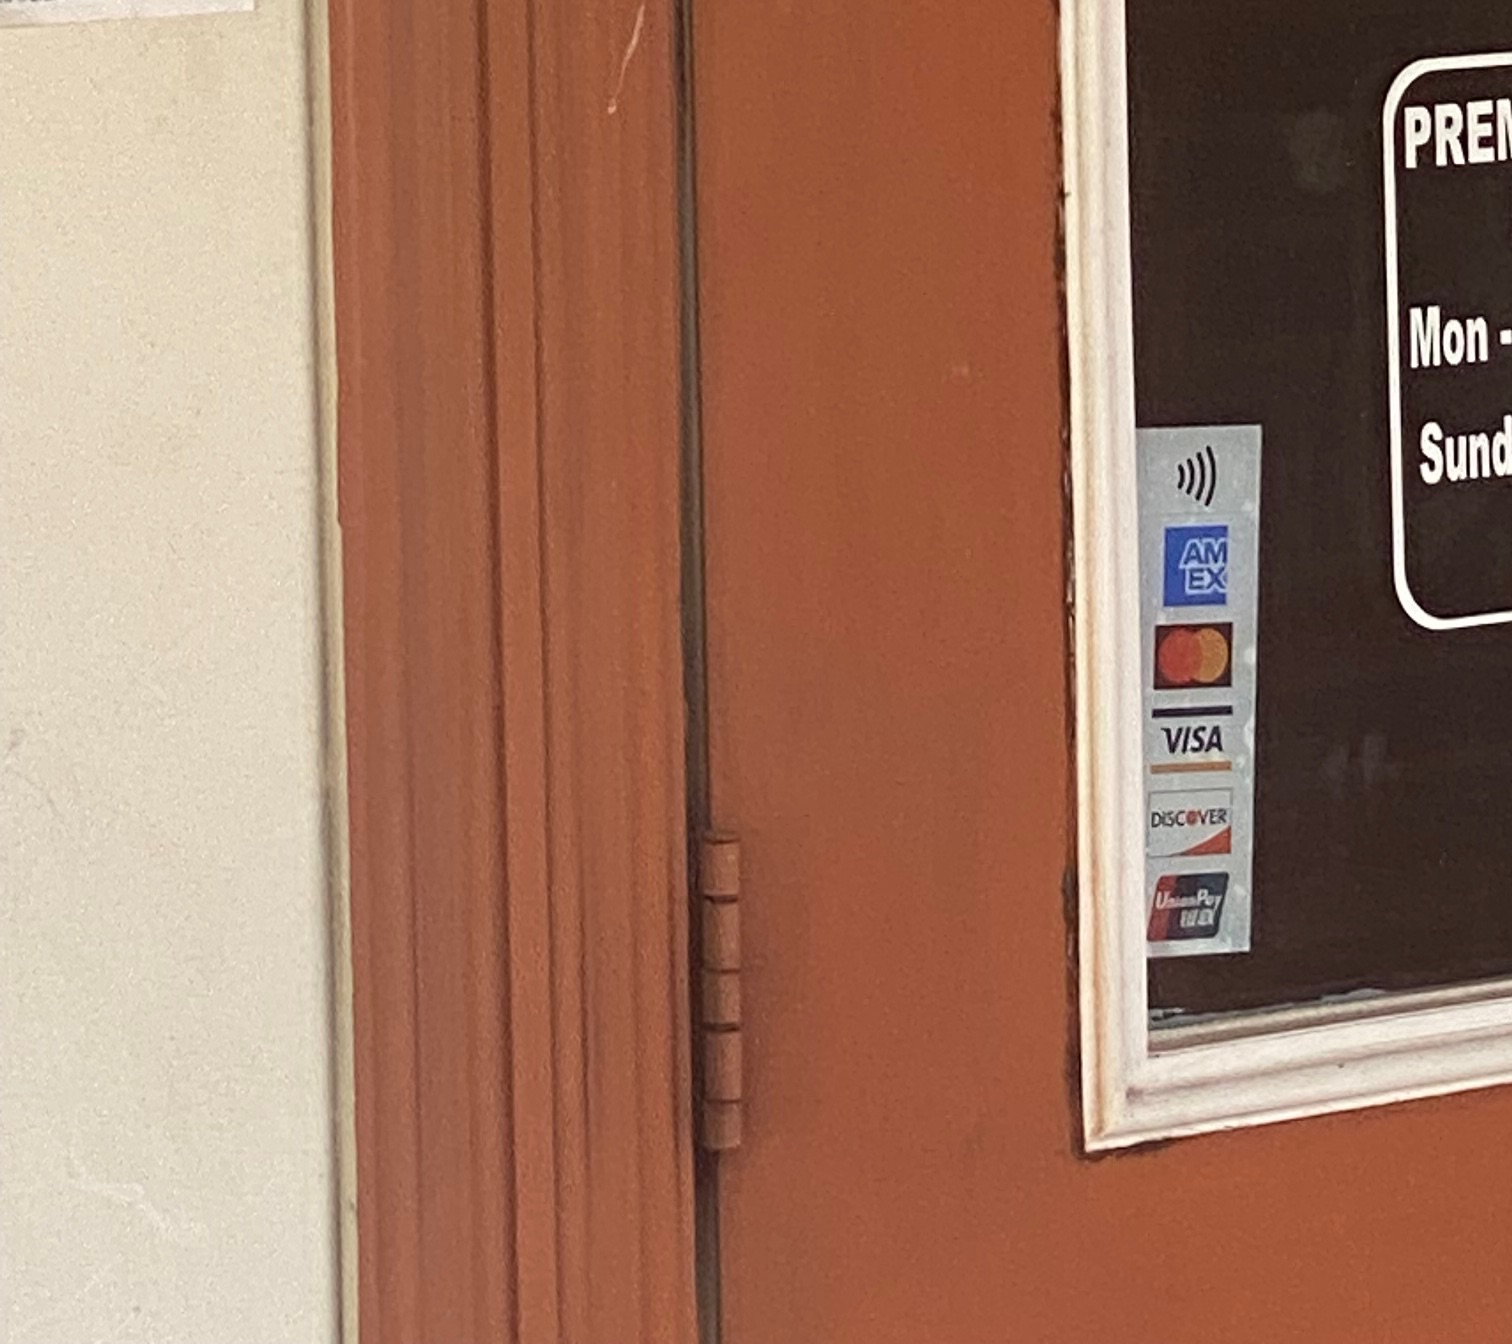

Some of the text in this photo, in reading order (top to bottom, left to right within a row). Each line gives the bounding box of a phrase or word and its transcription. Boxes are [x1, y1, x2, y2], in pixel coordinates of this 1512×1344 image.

[1410, 305, 1489, 369] Mon
[1179, 538, 1227, 567] AM
[1185, 566, 1226, 594] EX
[1161, 725, 1223, 754] VISA
[1151, 808, 1227, 828] DISCOVER
